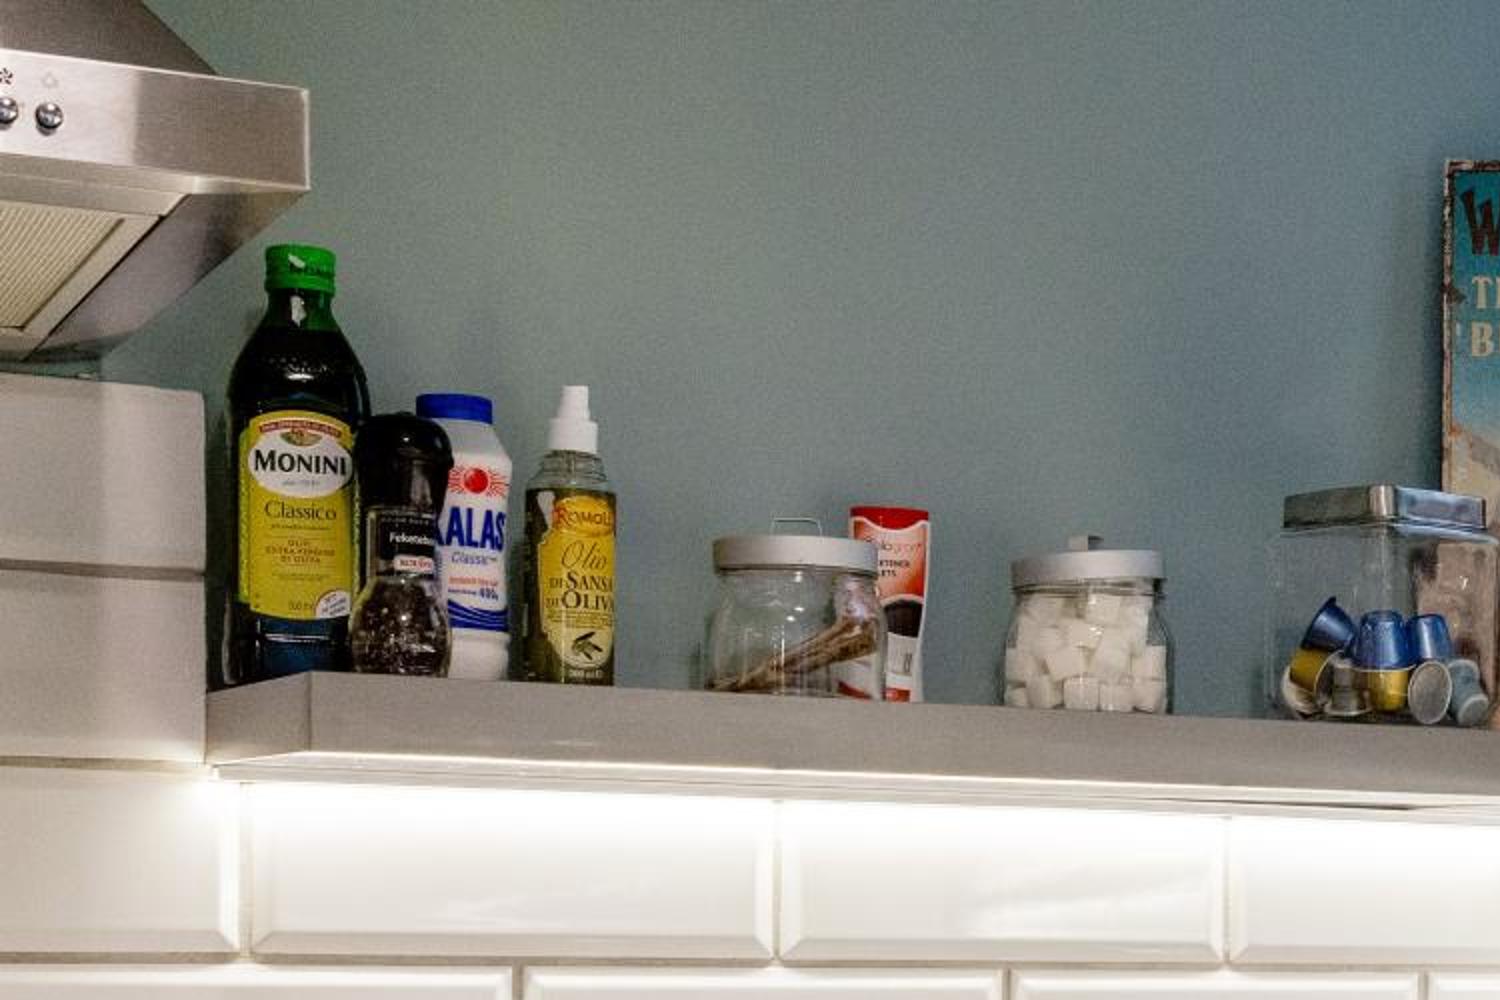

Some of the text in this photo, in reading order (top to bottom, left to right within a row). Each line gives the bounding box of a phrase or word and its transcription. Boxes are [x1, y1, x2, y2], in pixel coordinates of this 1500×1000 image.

[254, 449, 347, 477] MONINI
[264, 500, 337, 520] Classico
[435, 506, 506, 552] ALAS
[561, 540, 607, 570] Olio
